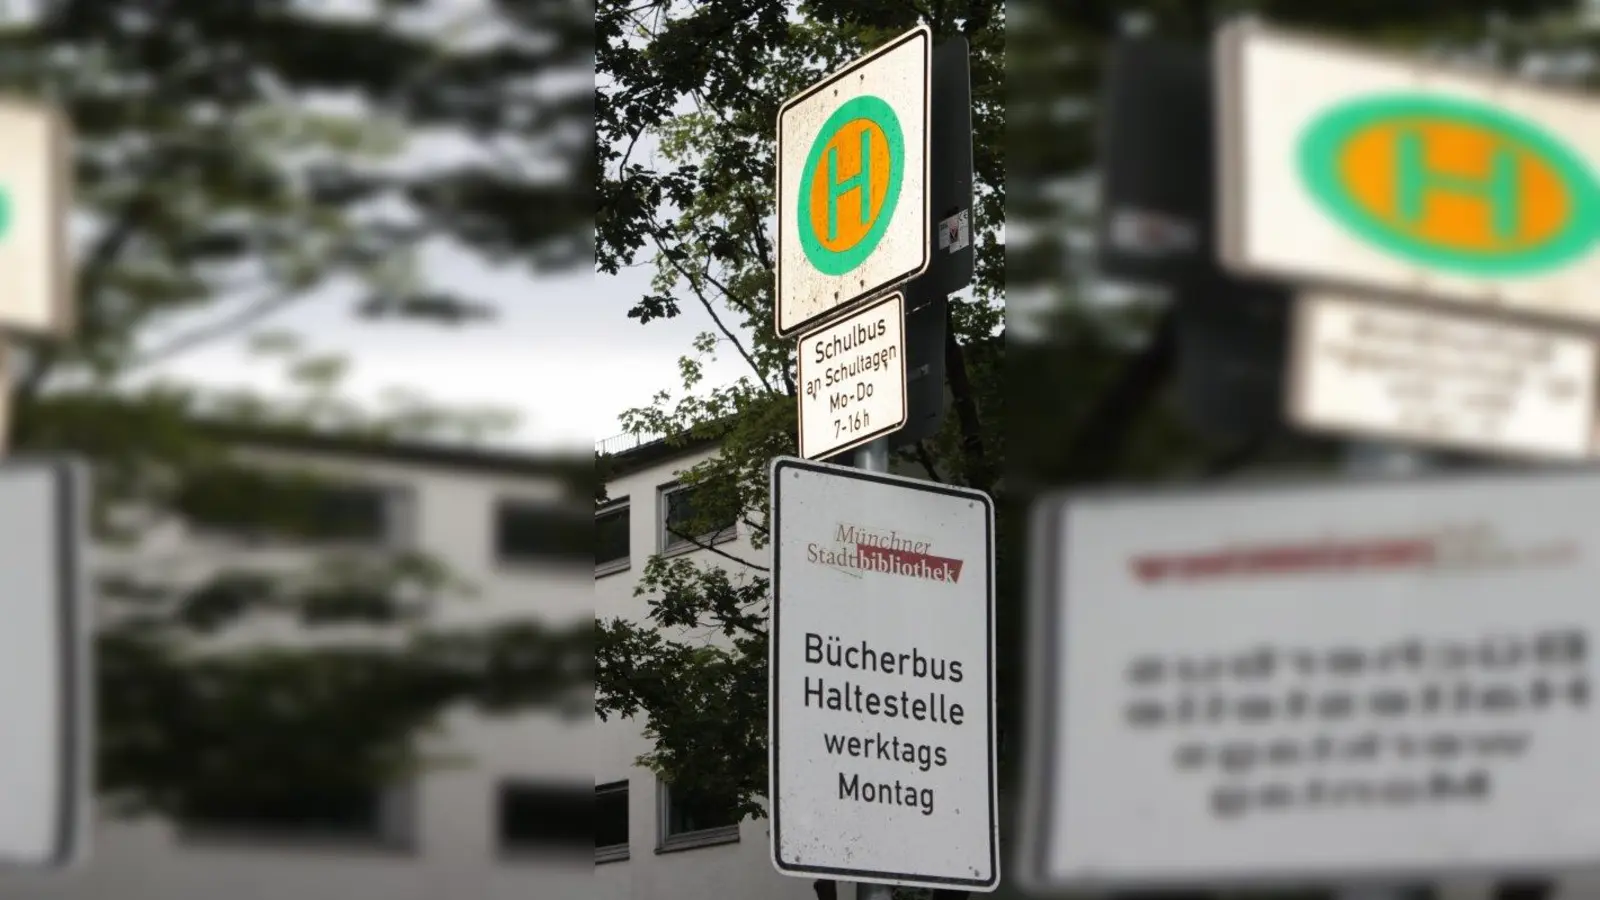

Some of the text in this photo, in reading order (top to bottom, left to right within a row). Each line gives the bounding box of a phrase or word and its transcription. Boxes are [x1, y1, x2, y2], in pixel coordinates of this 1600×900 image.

[828, 128, 871, 243] H
[815, 319, 886, 364] Schulbus
[806, 345, 896, 395] an Schultagen
[830, 382, 873, 413] Mo-Do
[836, 524, 931, 555] Münchner
[807, 542, 955, 584] Stadtbibliothek
[805, 632, 963, 682] Bücherbus
[804, 676, 964, 725] Haltestelle
[824, 732, 947, 772] werktags
[838, 772, 933, 815] Montag
